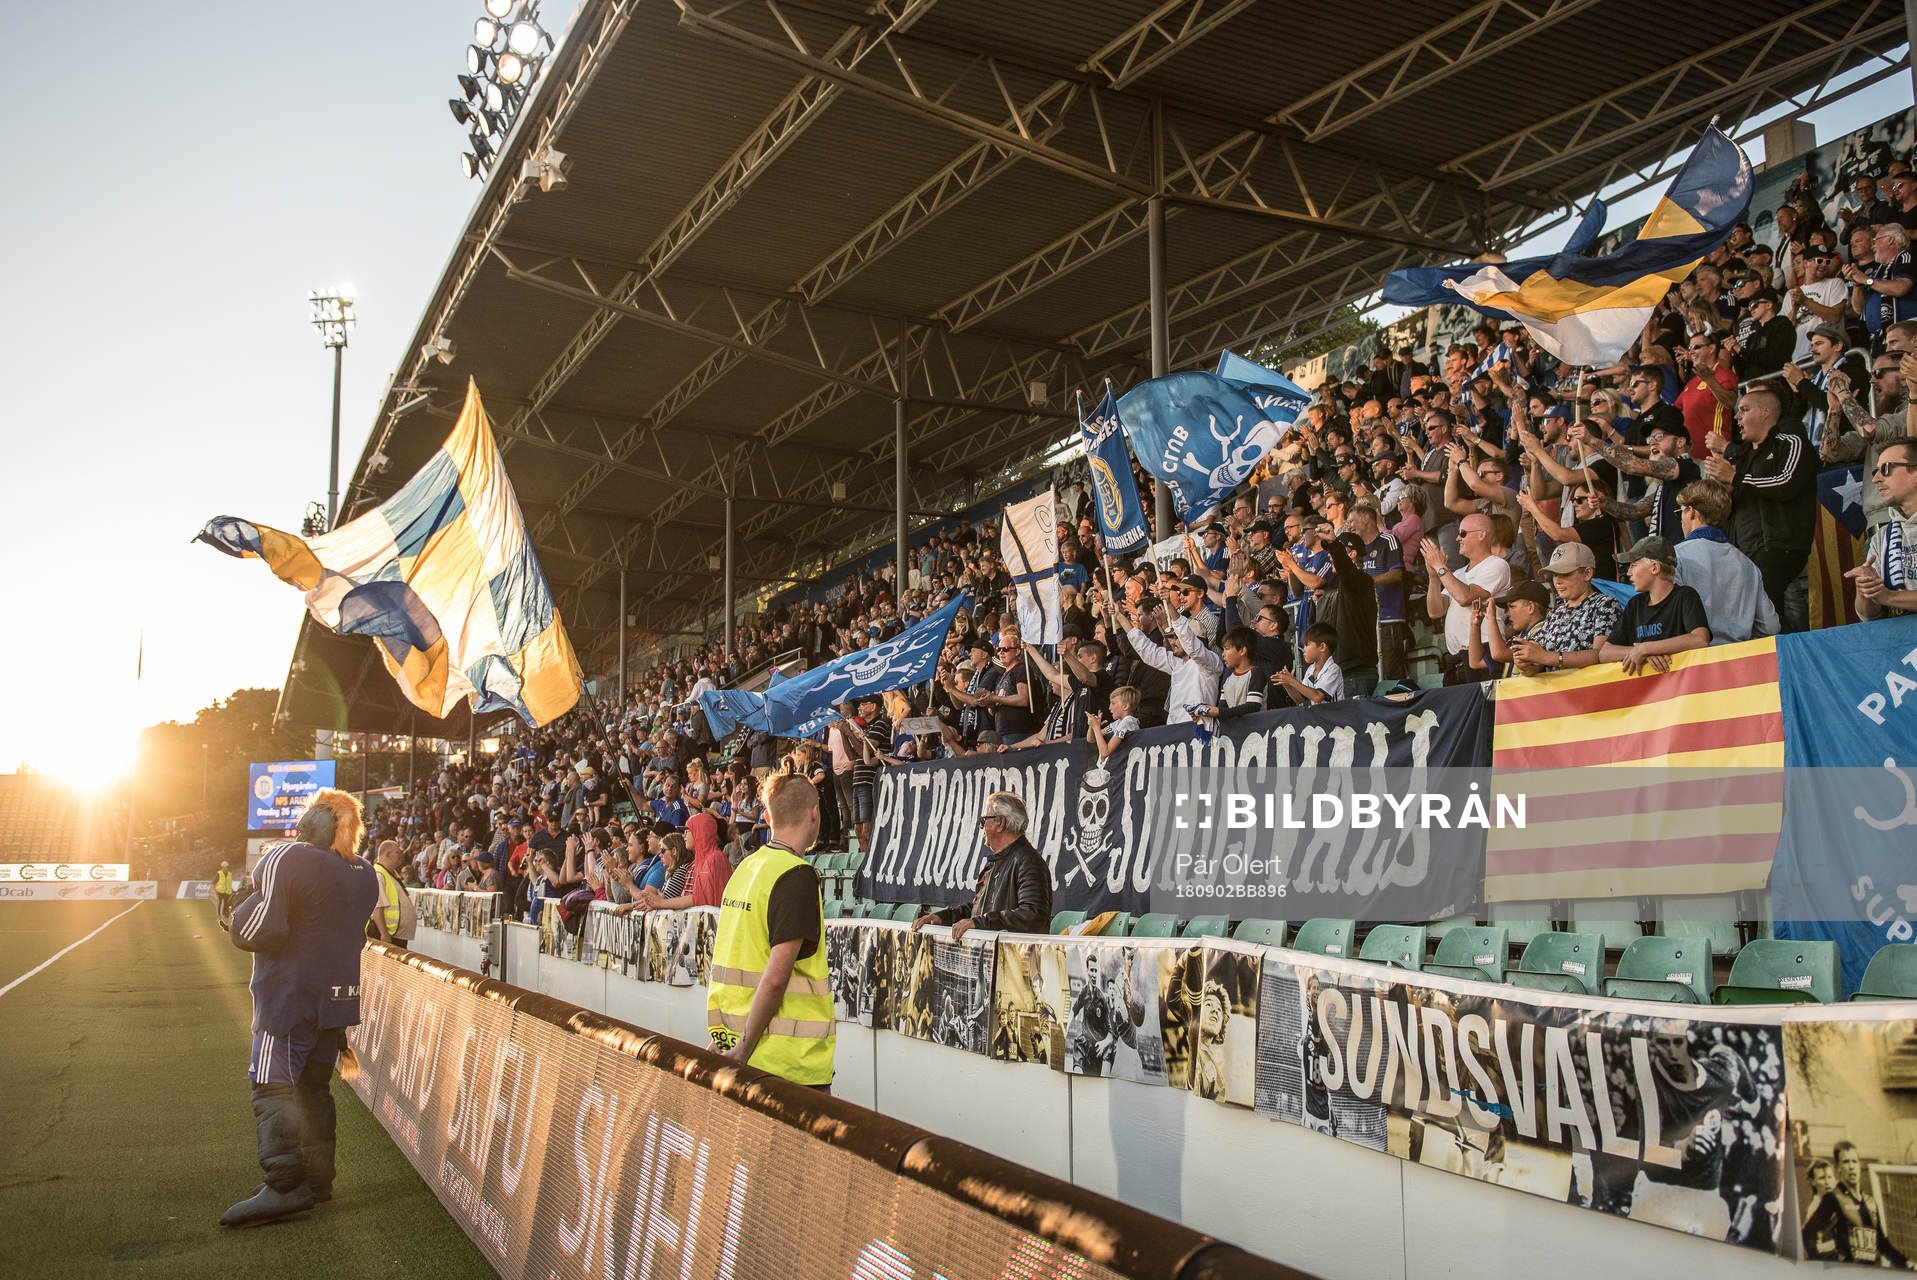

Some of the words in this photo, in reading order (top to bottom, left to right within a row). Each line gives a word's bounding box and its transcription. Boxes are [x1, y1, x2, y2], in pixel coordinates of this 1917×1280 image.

[1637, 623, 1662, 637] VAMOS
[862, 757, 1069, 892] PATRONNA
[1107, 709, 1440, 898] SUNDSVALL
[0, 888, 34, 897] Ocab
[390, 988, 449, 1112] SKIFU
[449, 1023, 543, 1198] SKIFU
[1317, 989, 1683, 1170] SUNDSVALL
